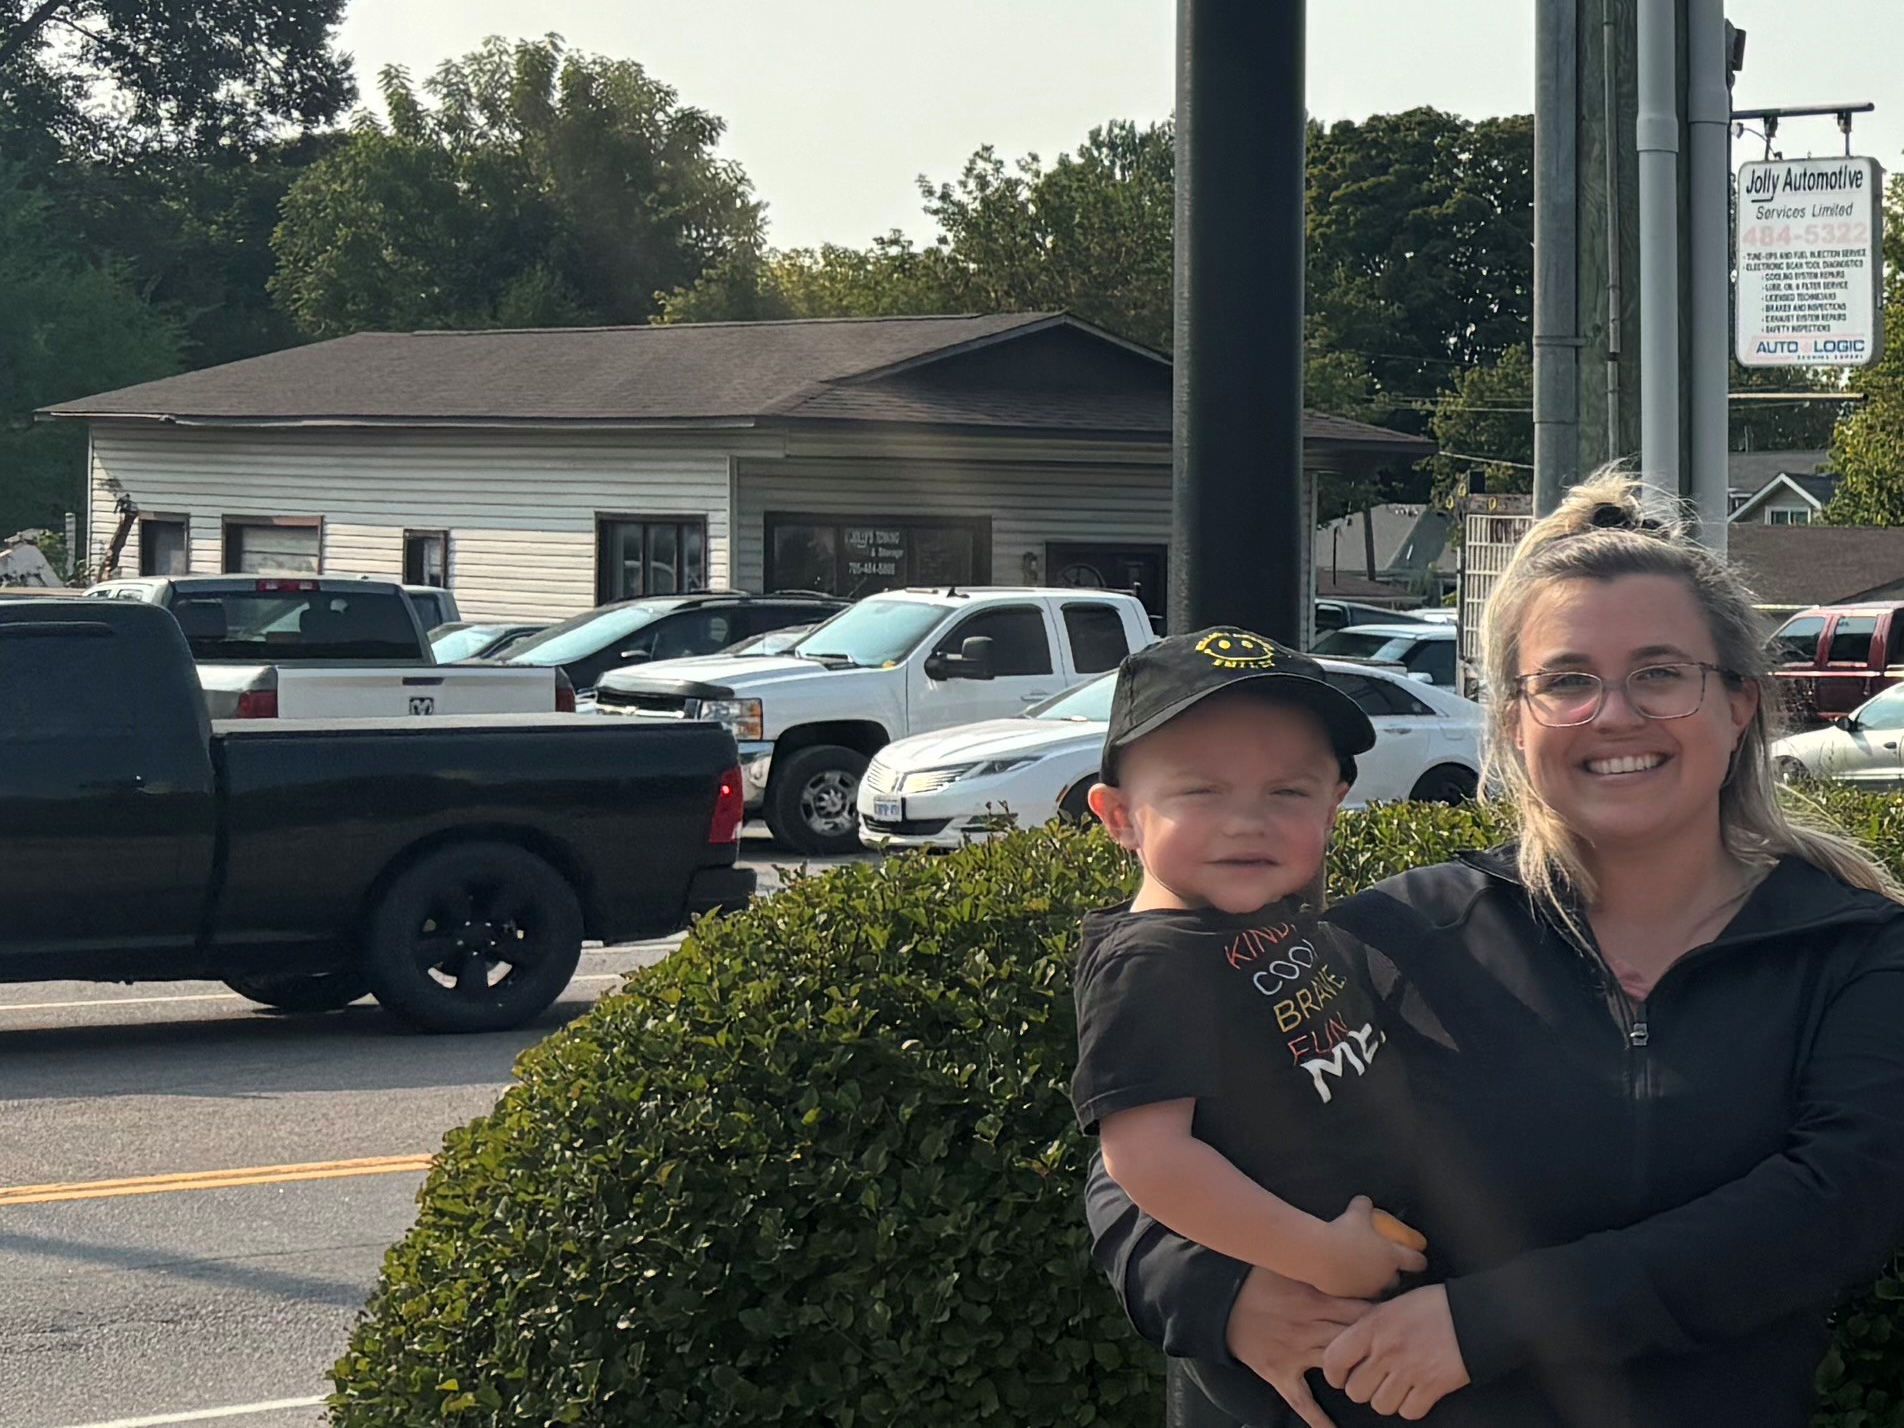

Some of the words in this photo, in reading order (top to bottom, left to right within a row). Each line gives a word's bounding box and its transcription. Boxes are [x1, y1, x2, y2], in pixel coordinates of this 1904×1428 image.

[1746, 169, 1779, 203] Jolly
[1782, 165, 1863, 193] Automotive
[1756, 205, 1806, 220] Services
[1812, 202, 1854, 218] Limited
[1743, 222, 1868, 246] 484-5322
[1756, 340, 1799, 354] AUTO
[1813, 339, 1865, 353] LOGIC
